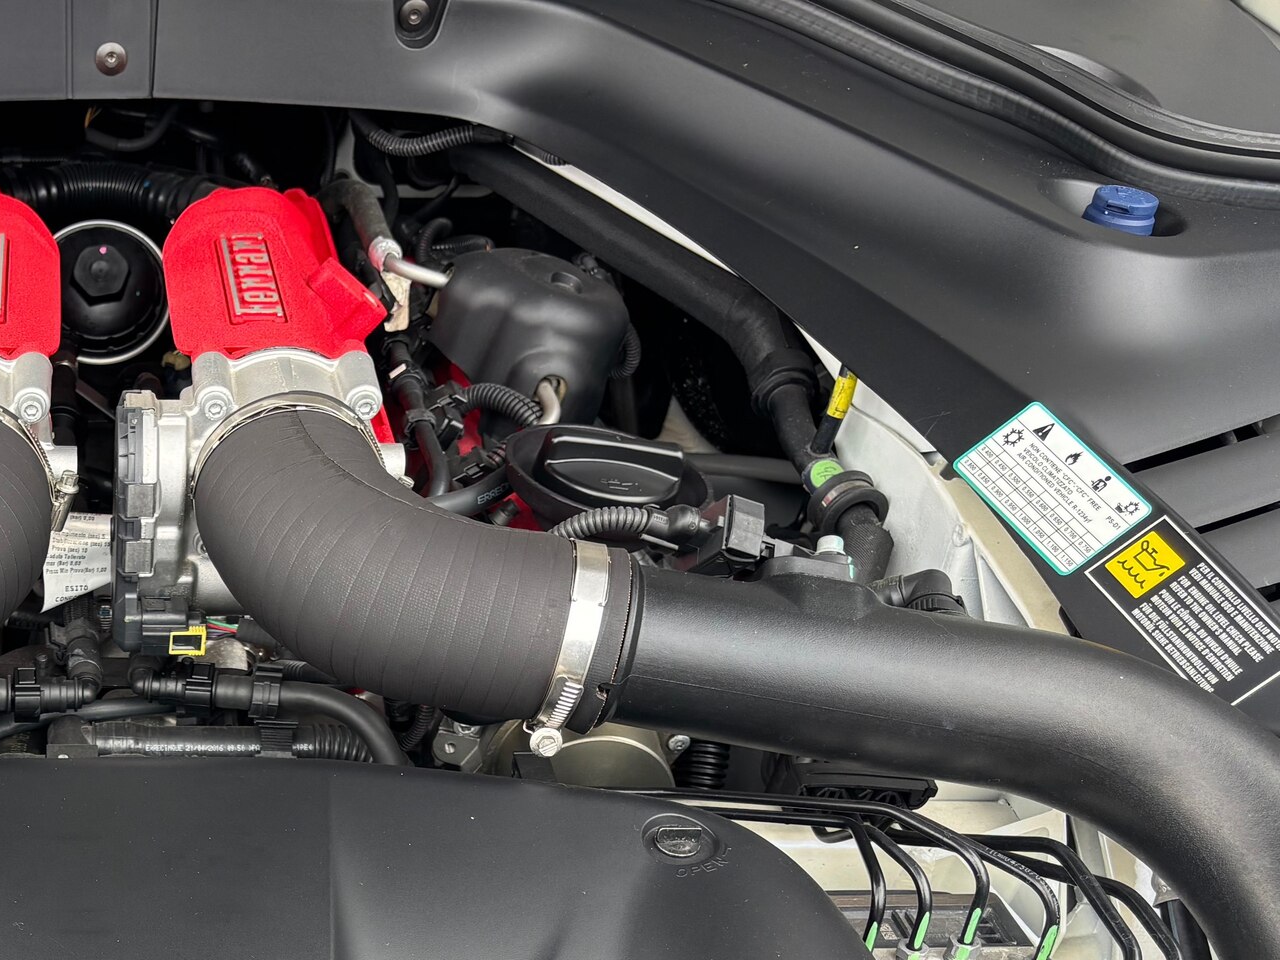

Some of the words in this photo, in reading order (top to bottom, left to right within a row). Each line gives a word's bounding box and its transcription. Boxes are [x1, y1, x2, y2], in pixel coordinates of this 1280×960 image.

[1017, 452, 1026, 460] AIR
[1024, 459, 1054, 488] CONDITIONED
[1053, 487, 1073, 506] VEHICLE
[1023, 447, 1043, 466] VEICOLO
[1041, 465, 1073, 495] CLIMATIZZATO
[1029, 442, 1039, 453] NON
[1039, 452, 1062, 473] CONTIENE
[1087, 497, 1101, 511] FREE
[65, 584, 88, 592] ESITO
[1169, 581, 1187, 599] REFER
[1183, 595, 1194, 605] TO
[1189, 601, 1203, 614] THE
[1198, 611, 1223, 635] OWNER'S
[1218, 632, 1242, 655] MANUAL
[1177, 575, 1191, 588] FOR
[1187, 585, 1209, 606] ENGINE
[1204, 603, 1216, 614] OIL
[1212, 611, 1229, 628] LEVEL
[1225, 625, 1246, 644] CHECK
[1241, 640, 1263, 662] PLEASE
[1188, 567, 1203, 581] VEDI
[1198, 578, 1225, 603] MANUALE
[1220, 600, 1235, 613] USO
[1233, 614, 1274, 654] MANUTENZIONE
[1196, 562, 1210, 574] PER
[1205, 571, 1215, 579] IL
[1211, 576, 1241, 605] CONTROLLO
[1236, 602, 1259, 623] LIVELLO
[1254, 621, 1270, 635] OLIO
[1148, 611, 1160, 622] DIE
[1204, 670, 1219, 684] VON
[1150, 594, 1172, 616] MOTEUR
[1168, 613, 1183, 627] VOIR
[1178, 624, 1189, 634] LA
[1184, 631, 1206, 651] NOTICE
[1201, 648, 1234, 681] D'ENTRETIEN
[1151, 629, 1169, 646] SIEHE
[1158, 588, 1175, 604] POUR
[1170, 601, 1181, 611] LE
[1196, 628, 1208, 638] DU
[1203, 635, 1225, 656] NIVEAU
[1220, 653, 1243, 675] D'HUILE
